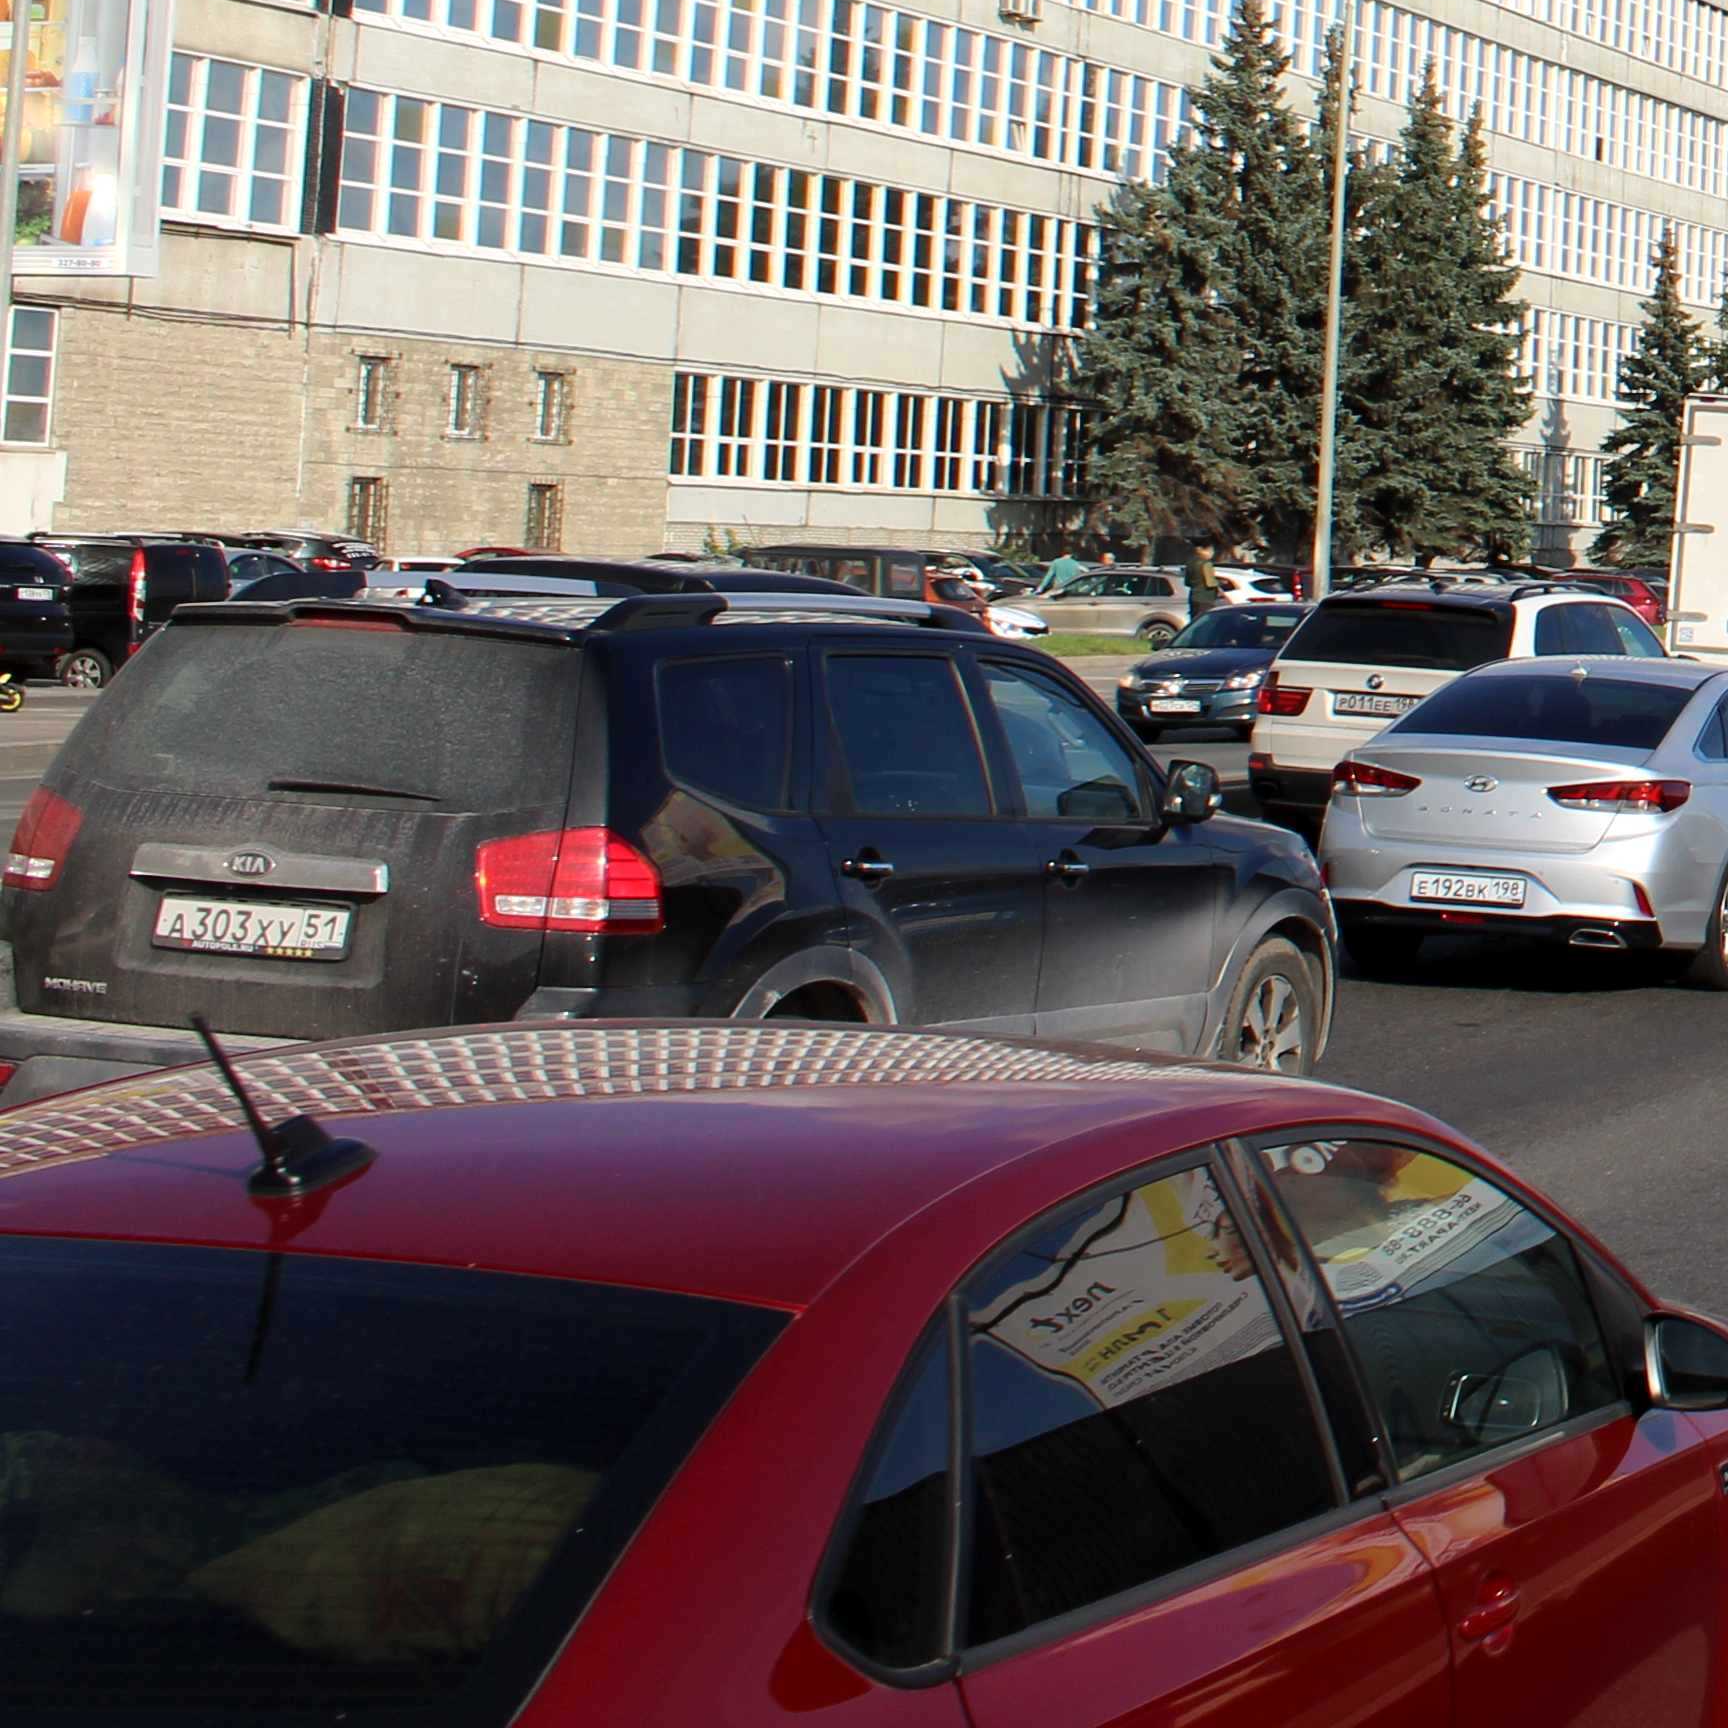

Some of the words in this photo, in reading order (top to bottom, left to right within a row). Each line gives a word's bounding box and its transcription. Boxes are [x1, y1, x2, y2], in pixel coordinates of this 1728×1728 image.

[232, 855, 266, 873] KIA
[167, 906, 296, 948] А303ХУ
[303, 913, 338, 942] 51
